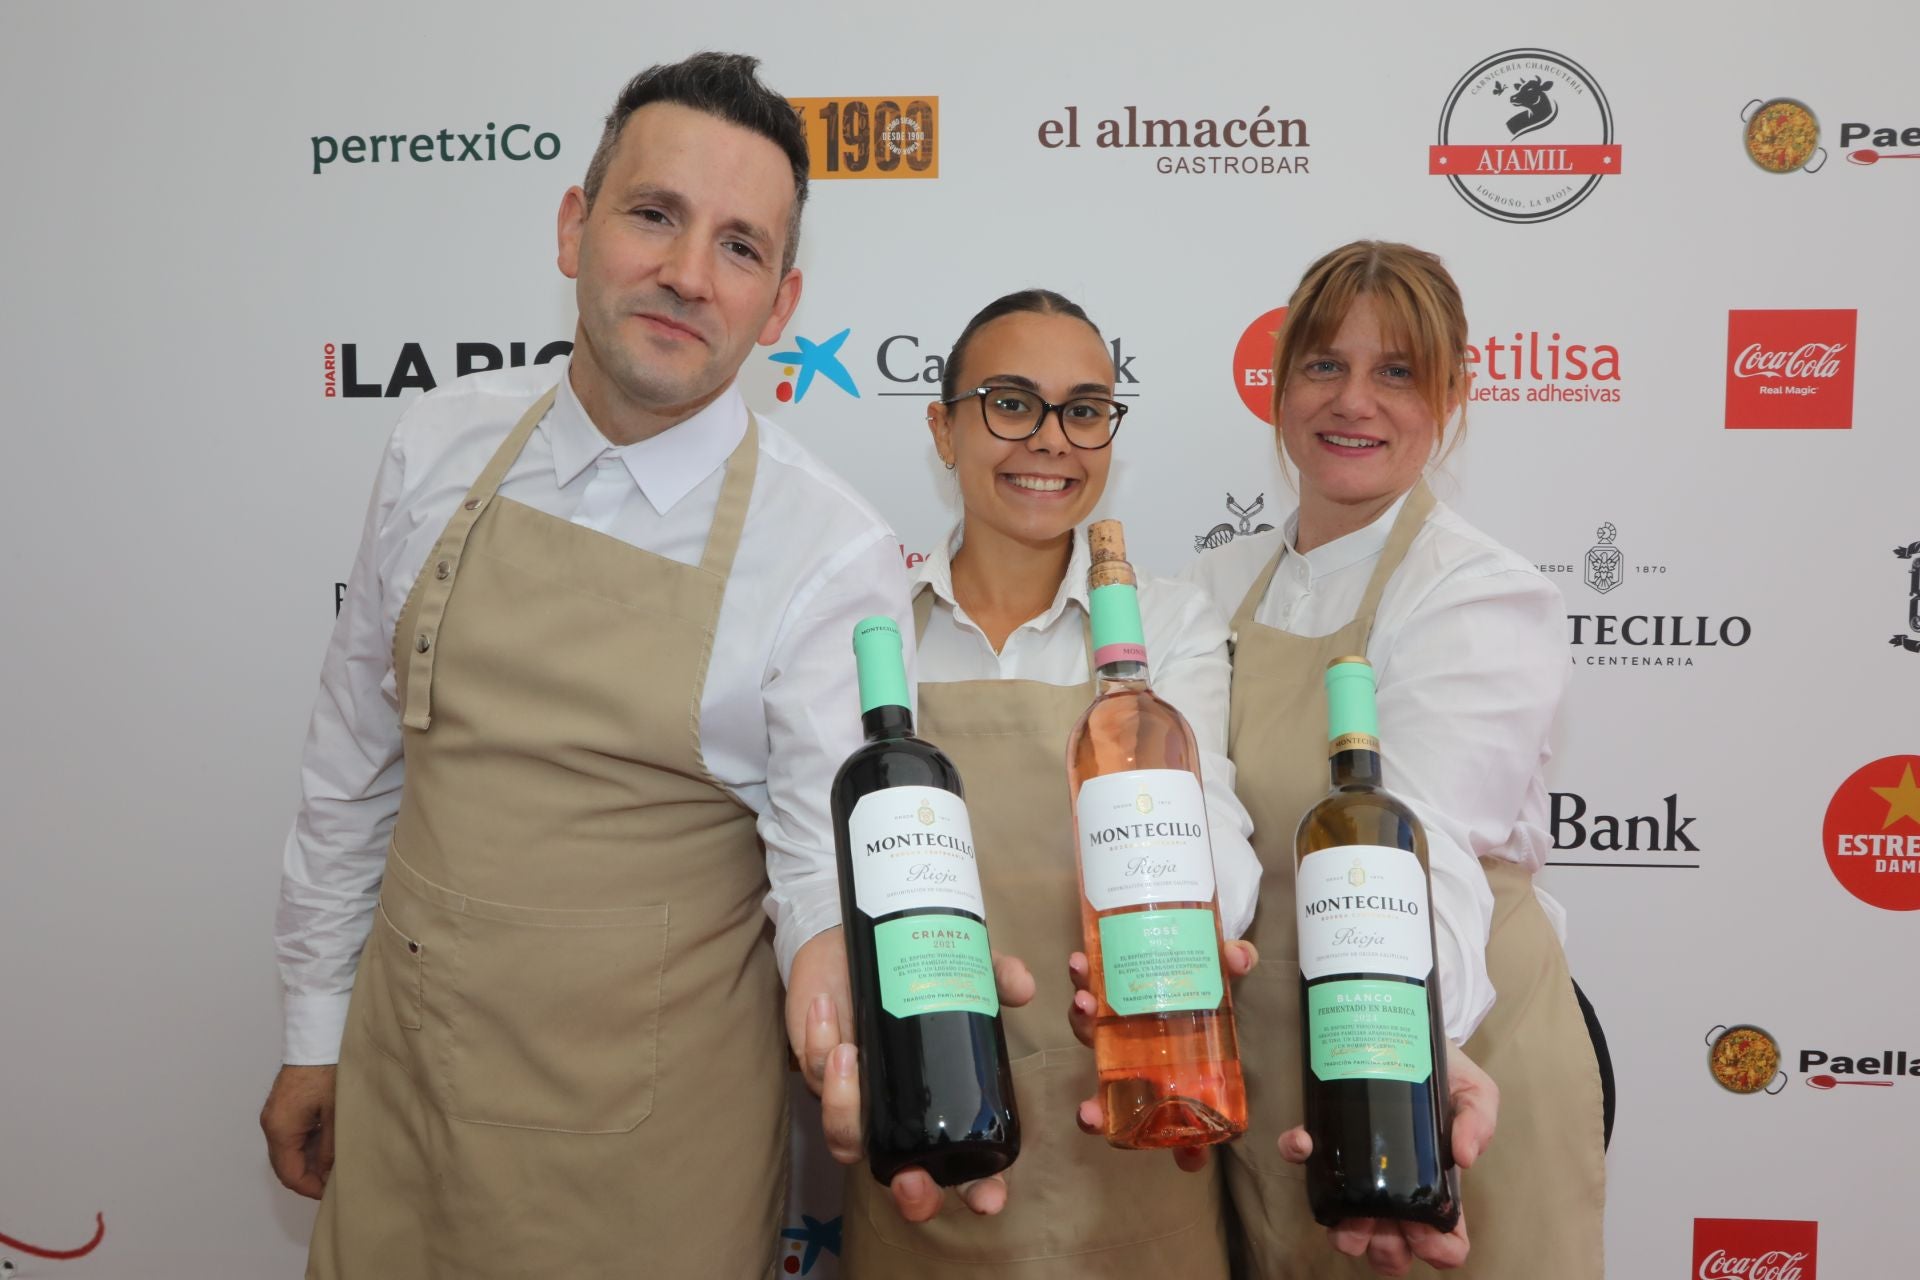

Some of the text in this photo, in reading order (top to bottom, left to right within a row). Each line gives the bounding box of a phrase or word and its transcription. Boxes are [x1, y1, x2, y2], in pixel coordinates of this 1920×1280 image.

[1471, 61, 1584, 95] CARNICERÍA CHARCUTERÍA
[819, 101, 933, 171] 1900
[882, 132, 906, 140] DESDE
[1038, 105, 1311, 148] el almacén
[311, 122, 561, 174] perretxiCo
[1156, 156, 1310, 175] GASTROBAR
[1475, 149, 1574, 174] AJAMIL
[1530, 200, 1542, 208] LA
[1546, 185, 1573, 204] RIOJA
[324, 343, 336, 397] DIARIO
[341, 342, 437, 398] LA
[1734, 343, 1848, 378] Coca-Cola
[1526, 384, 1621, 402] adhesivas
[1760, 386, 1817, 396] Real Magic
[1636, 566, 1667, 574] 1870
[1586, 656, 1694, 666] CENTENARIA
[1548, 792, 1700, 852] Bank
[1089, 822, 1202, 847] MONTECILLO
[866, 833, 974, 859] MONTECILLO
[906, 863, 958, 884] Rioja
[1124, 856, 1177, 878] Rioja
[1875, 859, 1920, 873] DAM
[1305, 896, 1419, 918] MONTECILLO
[911, 930, 971, 940] CRIANZA
[933, 941, 956, 949] 2021
[1331, 926, 1385, 948] Rioja
[1336, 994, 1392, 1003] BLANCO
[1317, 1004, 1416, 1016] FERMENTADO EN BARRICA
[1699, 1249, 1809, 1280] Coca-Cola
